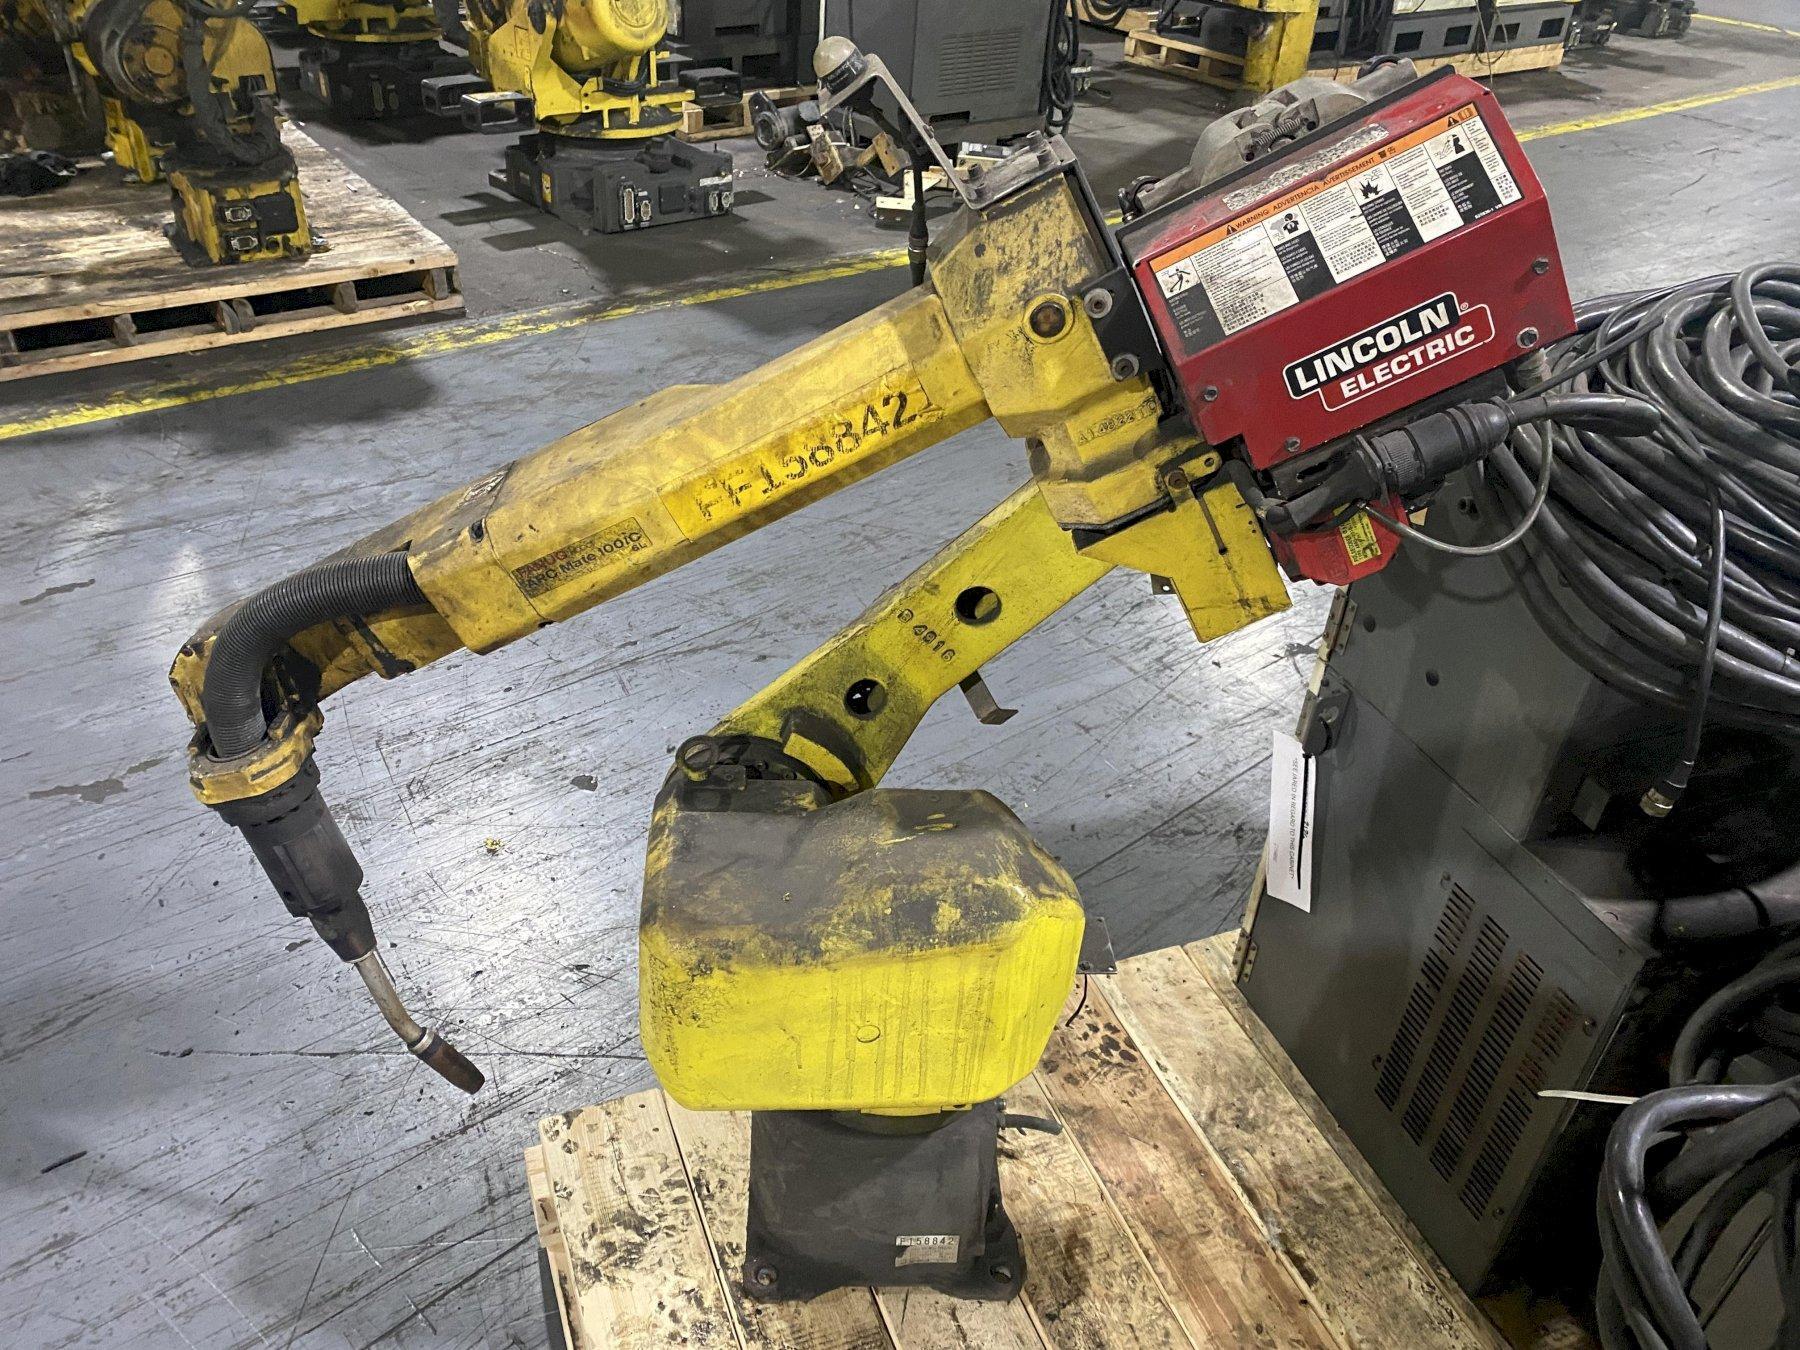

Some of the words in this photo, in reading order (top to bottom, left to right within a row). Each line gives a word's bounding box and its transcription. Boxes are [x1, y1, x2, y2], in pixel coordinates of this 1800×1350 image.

[1236, 209, 1270, 228] WARNING
[1273, 185, 1319, 211] ADVERTENCIA
[1323, 158, 1375, 186] AVERTISSEMENT
[1295, 302, 1450, 391] LINCOLN
[1339, 325, 1475, 399] ELECTRIC
[527, 568, 558, 588] ARC
[560, 553, 597, 573] Mate
[631, 542, 647, 552] 6L
